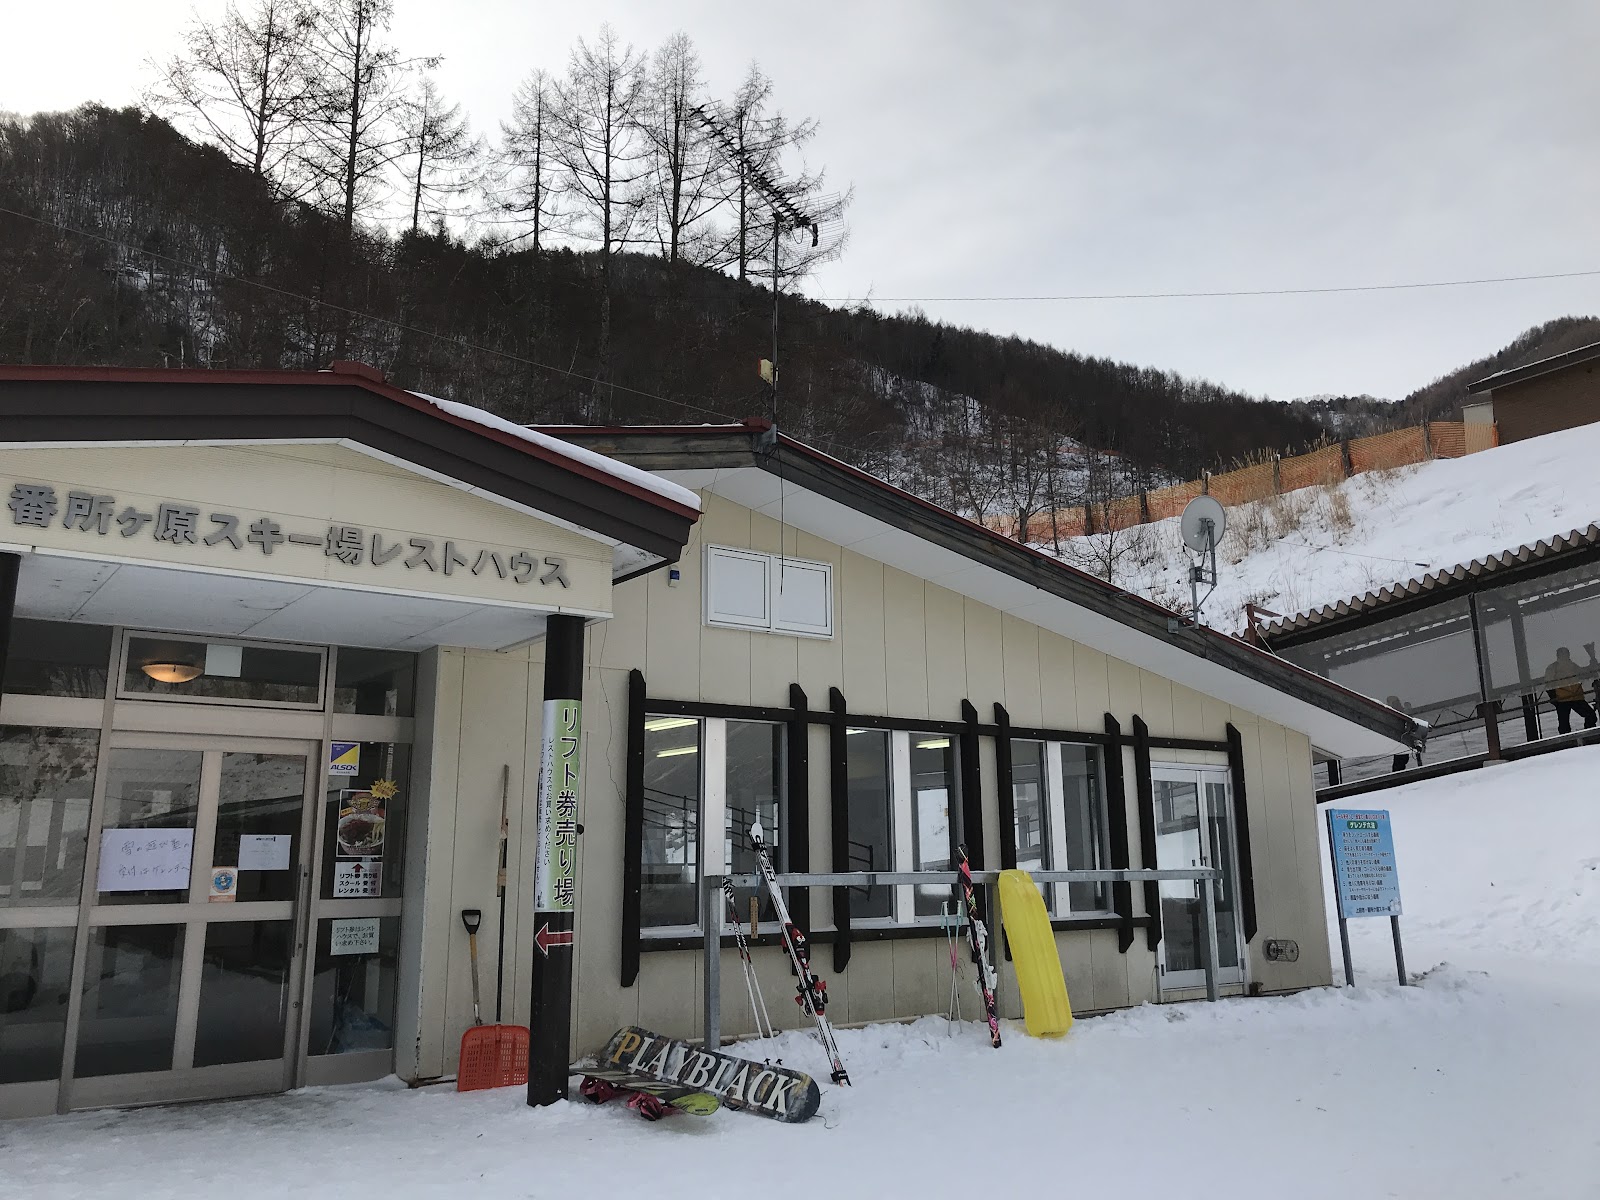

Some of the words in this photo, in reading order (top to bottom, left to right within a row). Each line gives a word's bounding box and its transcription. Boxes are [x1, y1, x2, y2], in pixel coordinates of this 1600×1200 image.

[9, 483, 571, 589] 番所ヶ原スキー場レストハウス
[553, 707, 577, 906] リフト券売り場
[610, 1031, 801, 1114] PLAYBLACK
